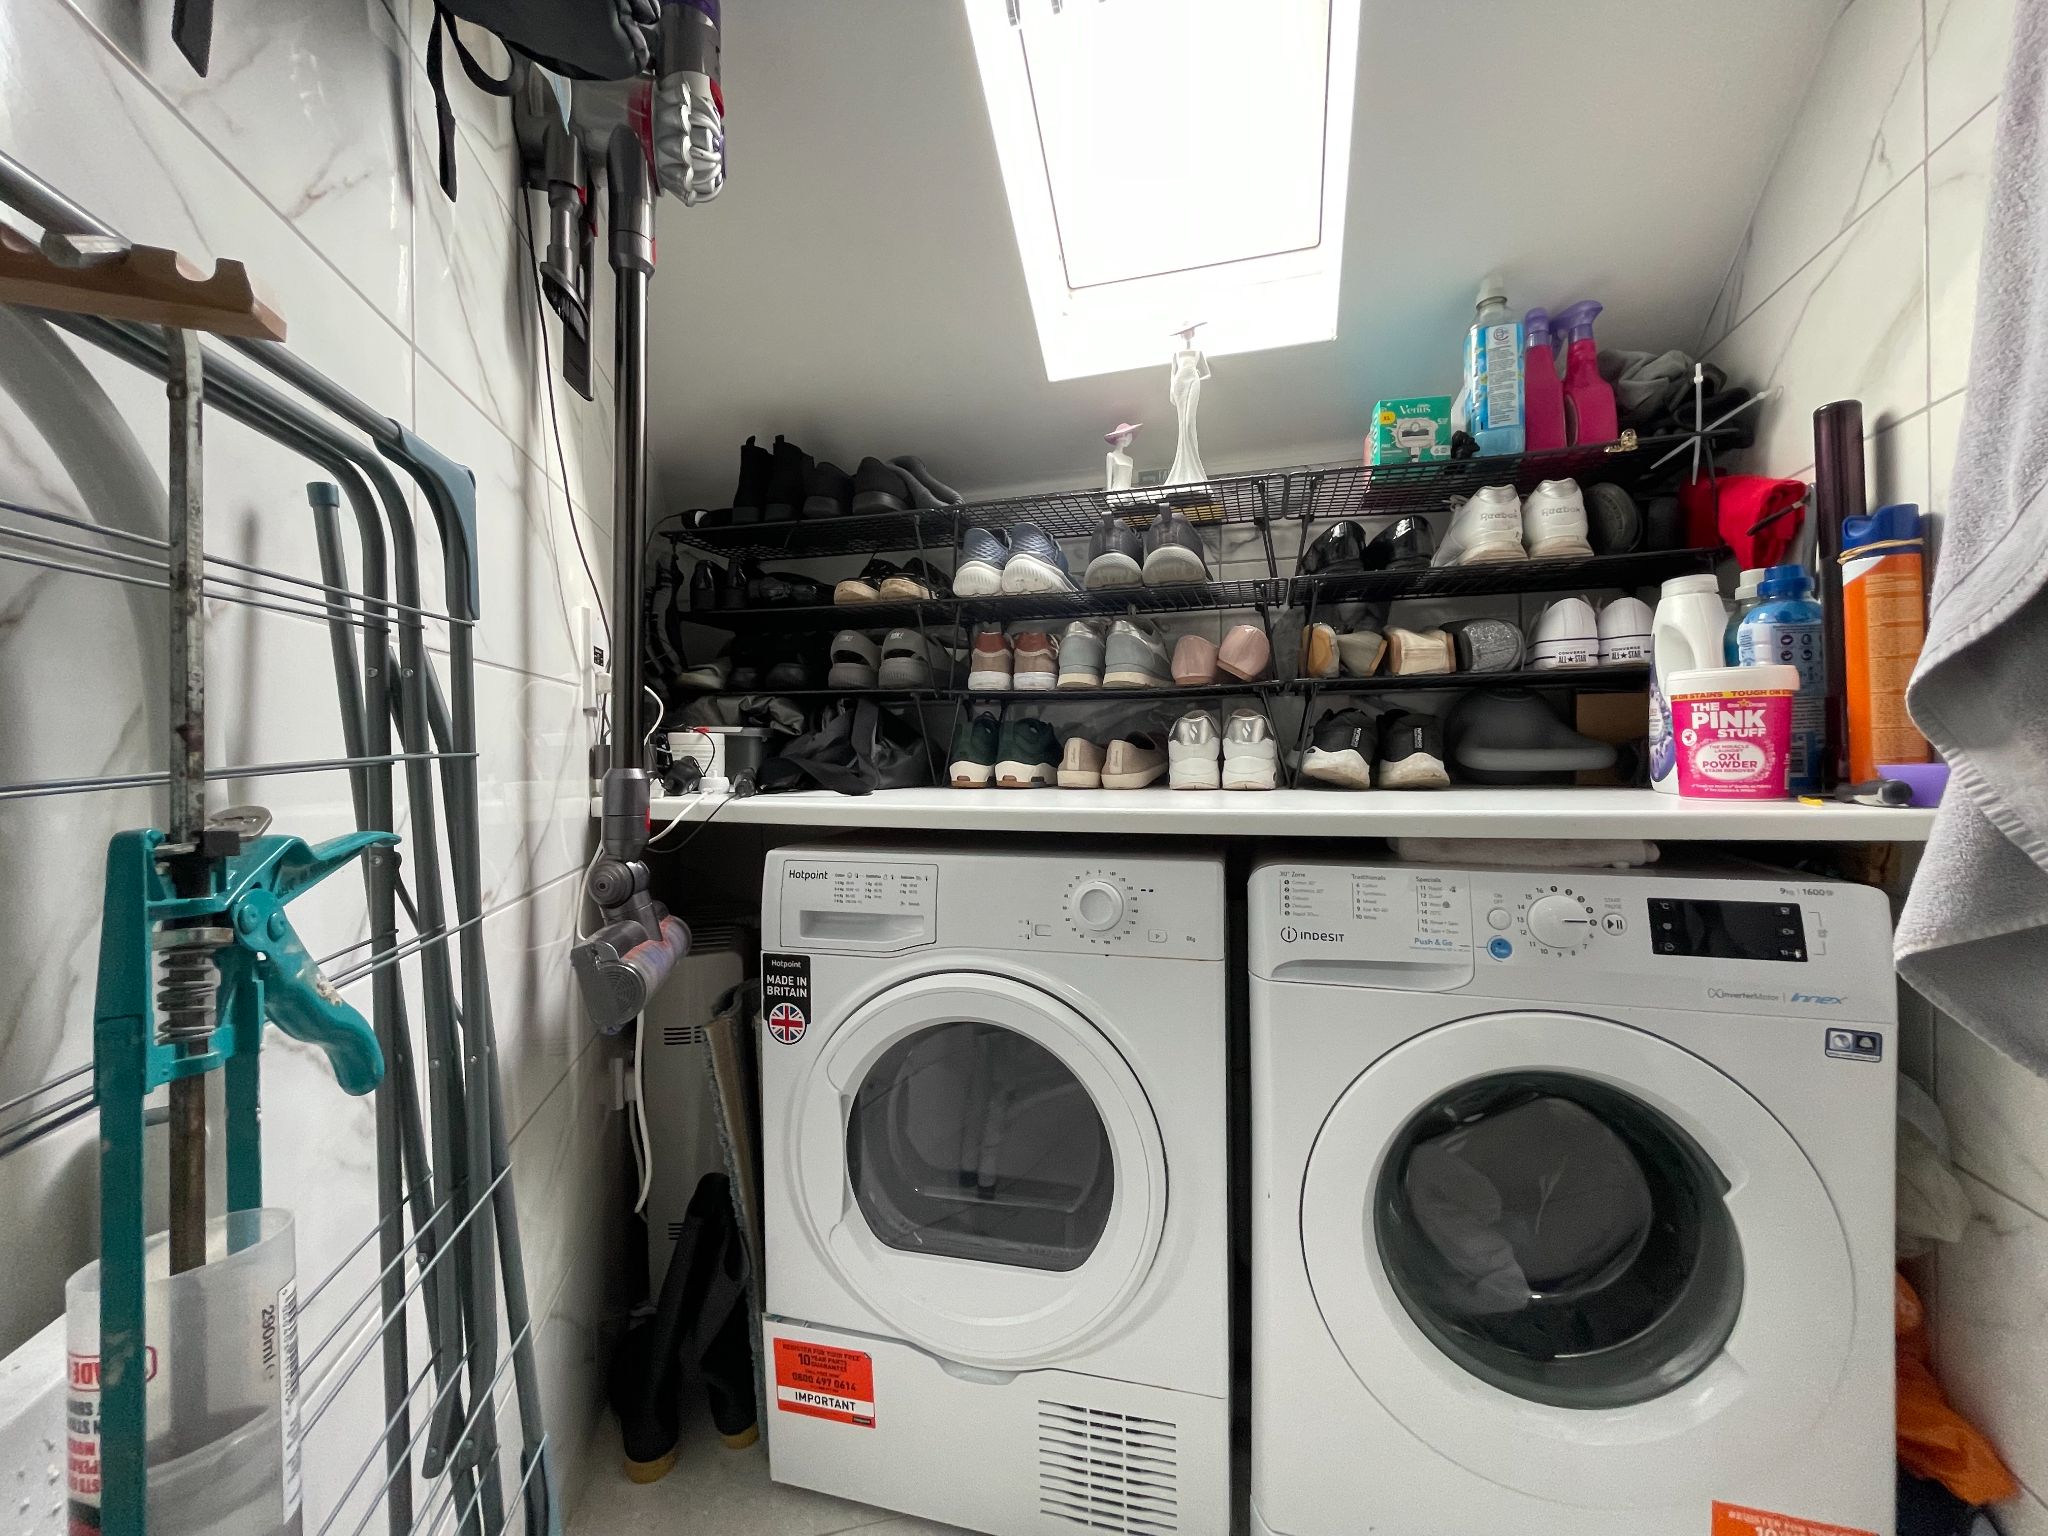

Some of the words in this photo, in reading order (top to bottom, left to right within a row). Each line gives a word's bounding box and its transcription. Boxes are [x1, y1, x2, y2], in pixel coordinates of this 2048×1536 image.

[1400, 404, 1431, 414] Venus
[1542, 506, 1580, 516] Reebok
[1612, 652, 1620, 660] ALL
[1628, 650, 1642, 658] STAR
[1691, 702, 1720, 711] THE
[1692, 710, 1766, 729] PINK
[1718, 728, 1766, 738] STUFF
[789, 870, 828, 880] Hotpoint
[1802, 888, 1825, 896] 1600
[772, 960, 802, 968] Hotpoint
[767, 975, 794, 985] MADE
[797, 977, 807, 986] IN
[767, 986, 807, 997] BRITAIN
[262, 1305, 276, 1364] 290ml
[798, 1353, 810, 1366] 10
[792, 1372, 814, 1383] 0800
[816, 1376, 832, 1387] 497
[834, 1380, 856, 1391] 0614
[795, 1392, 856, 1411] IMPORTANT
